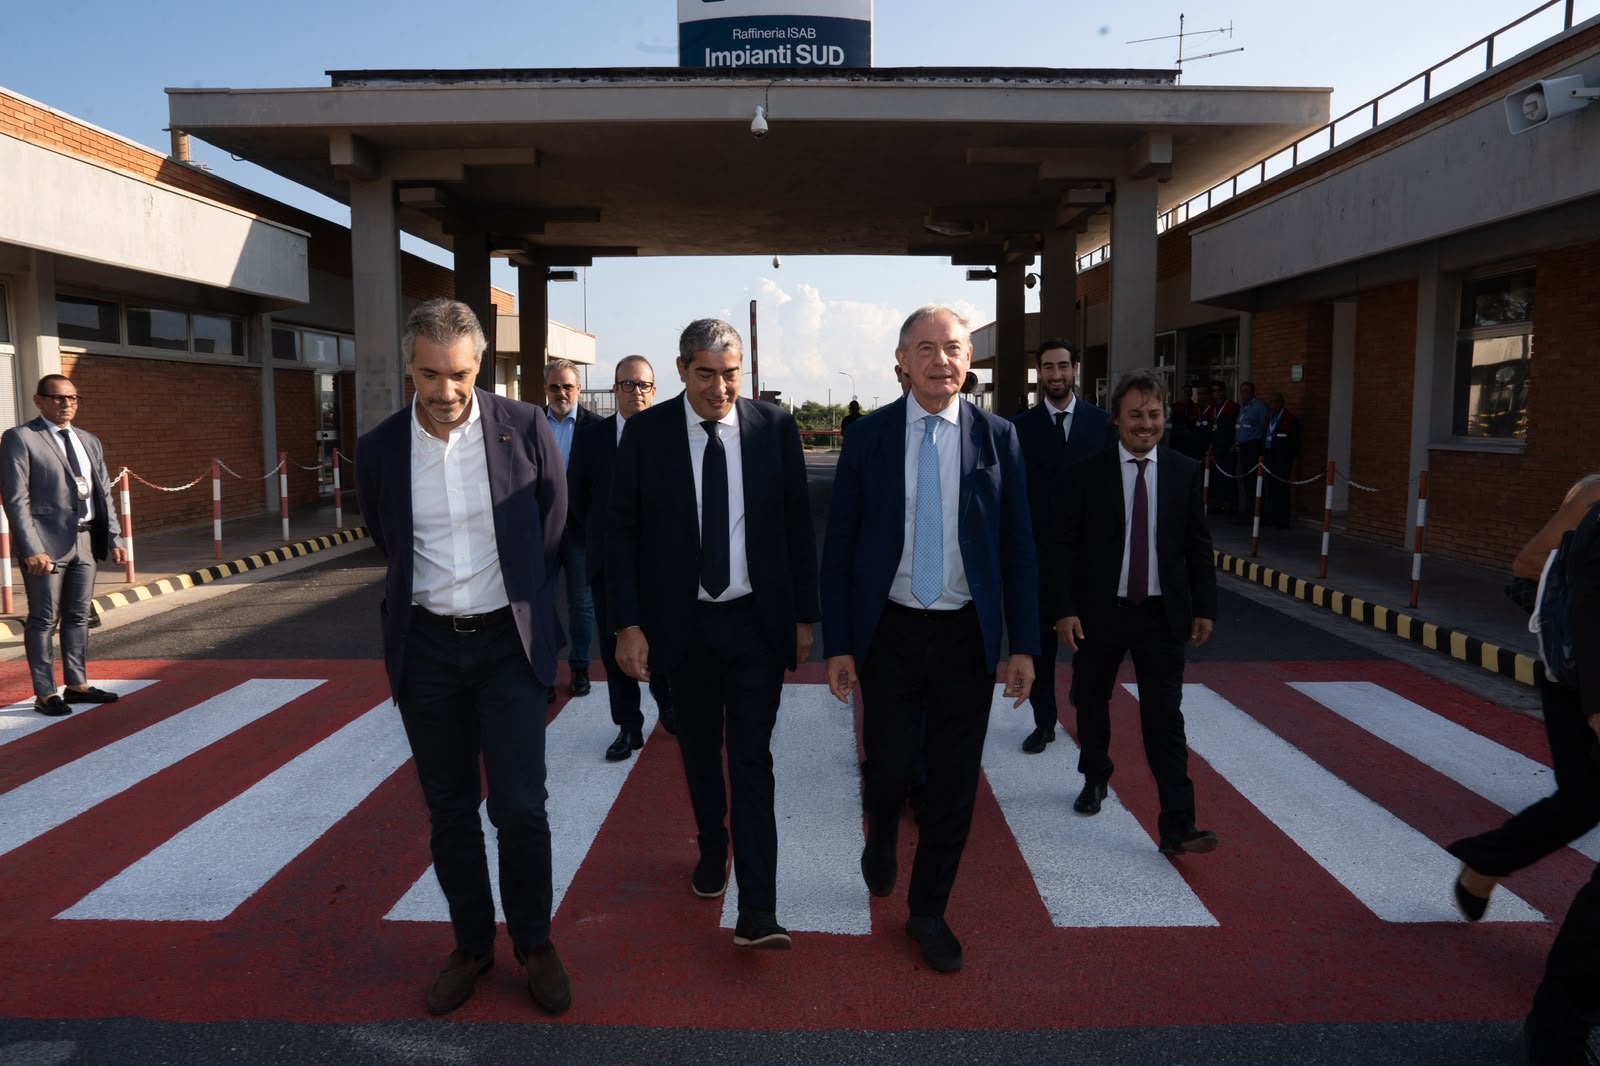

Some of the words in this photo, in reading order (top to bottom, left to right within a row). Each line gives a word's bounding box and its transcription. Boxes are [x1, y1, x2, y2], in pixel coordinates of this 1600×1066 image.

[732, 28, 786, 40] Raffineria
[787, 27, 816, 39] ISAB
[705, 44, 791, 68] Impianti
[795, 44, 845, 66] SUD
